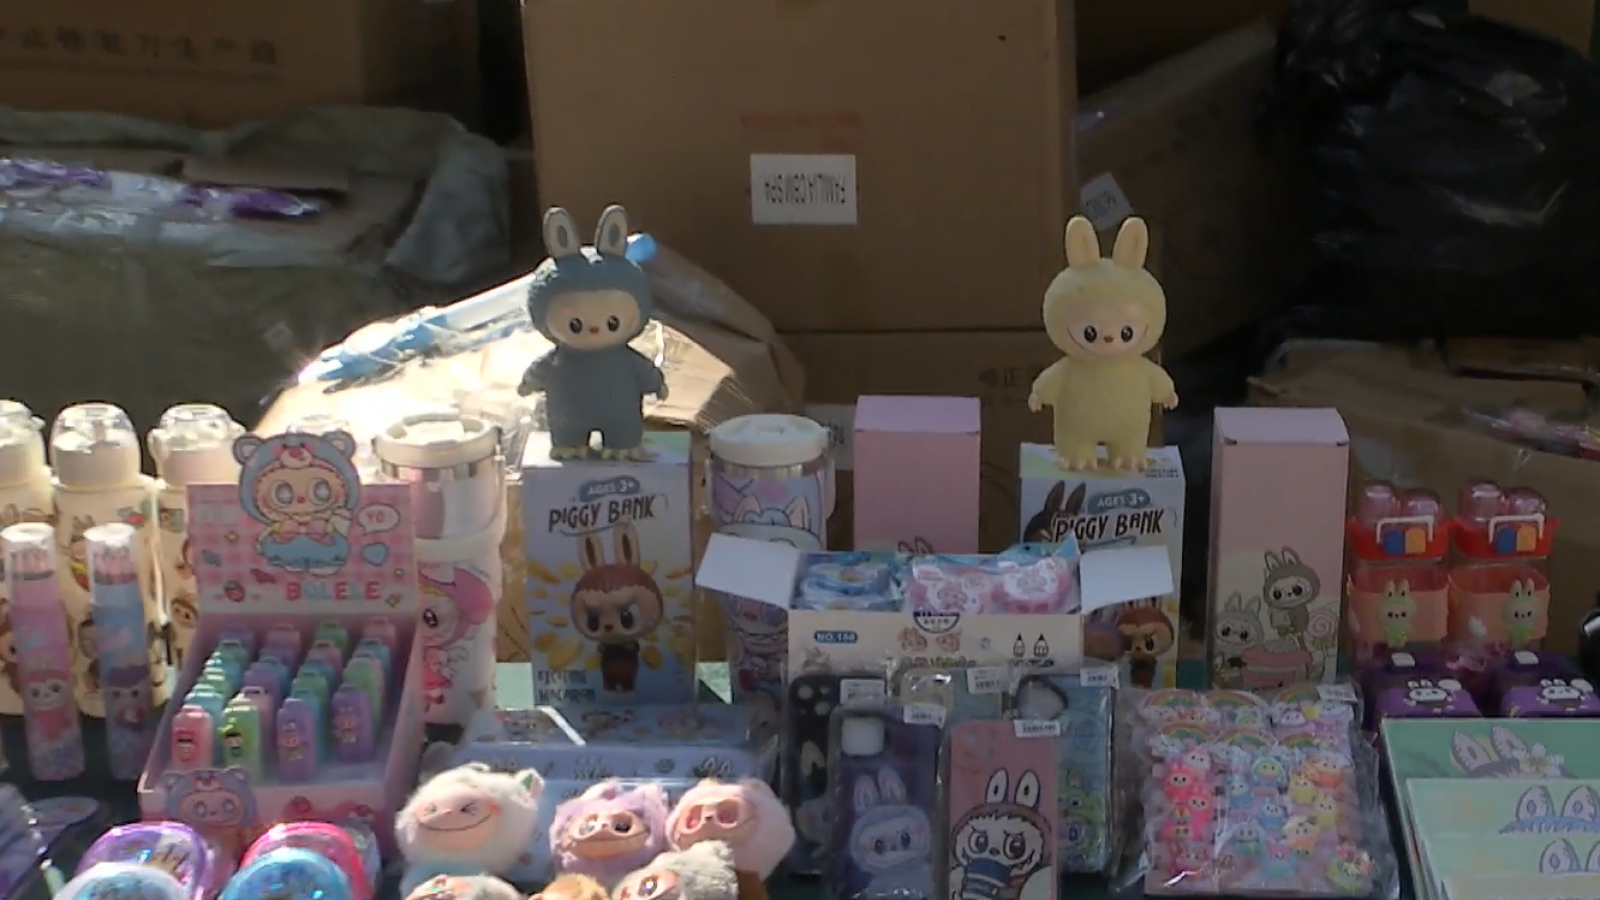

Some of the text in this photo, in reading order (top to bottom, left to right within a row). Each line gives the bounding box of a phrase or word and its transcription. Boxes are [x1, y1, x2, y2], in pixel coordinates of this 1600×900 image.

[548, 496, 656, 533] PIGGY BANK
[1055, 509, 1164, 543] PIGGY BANK
